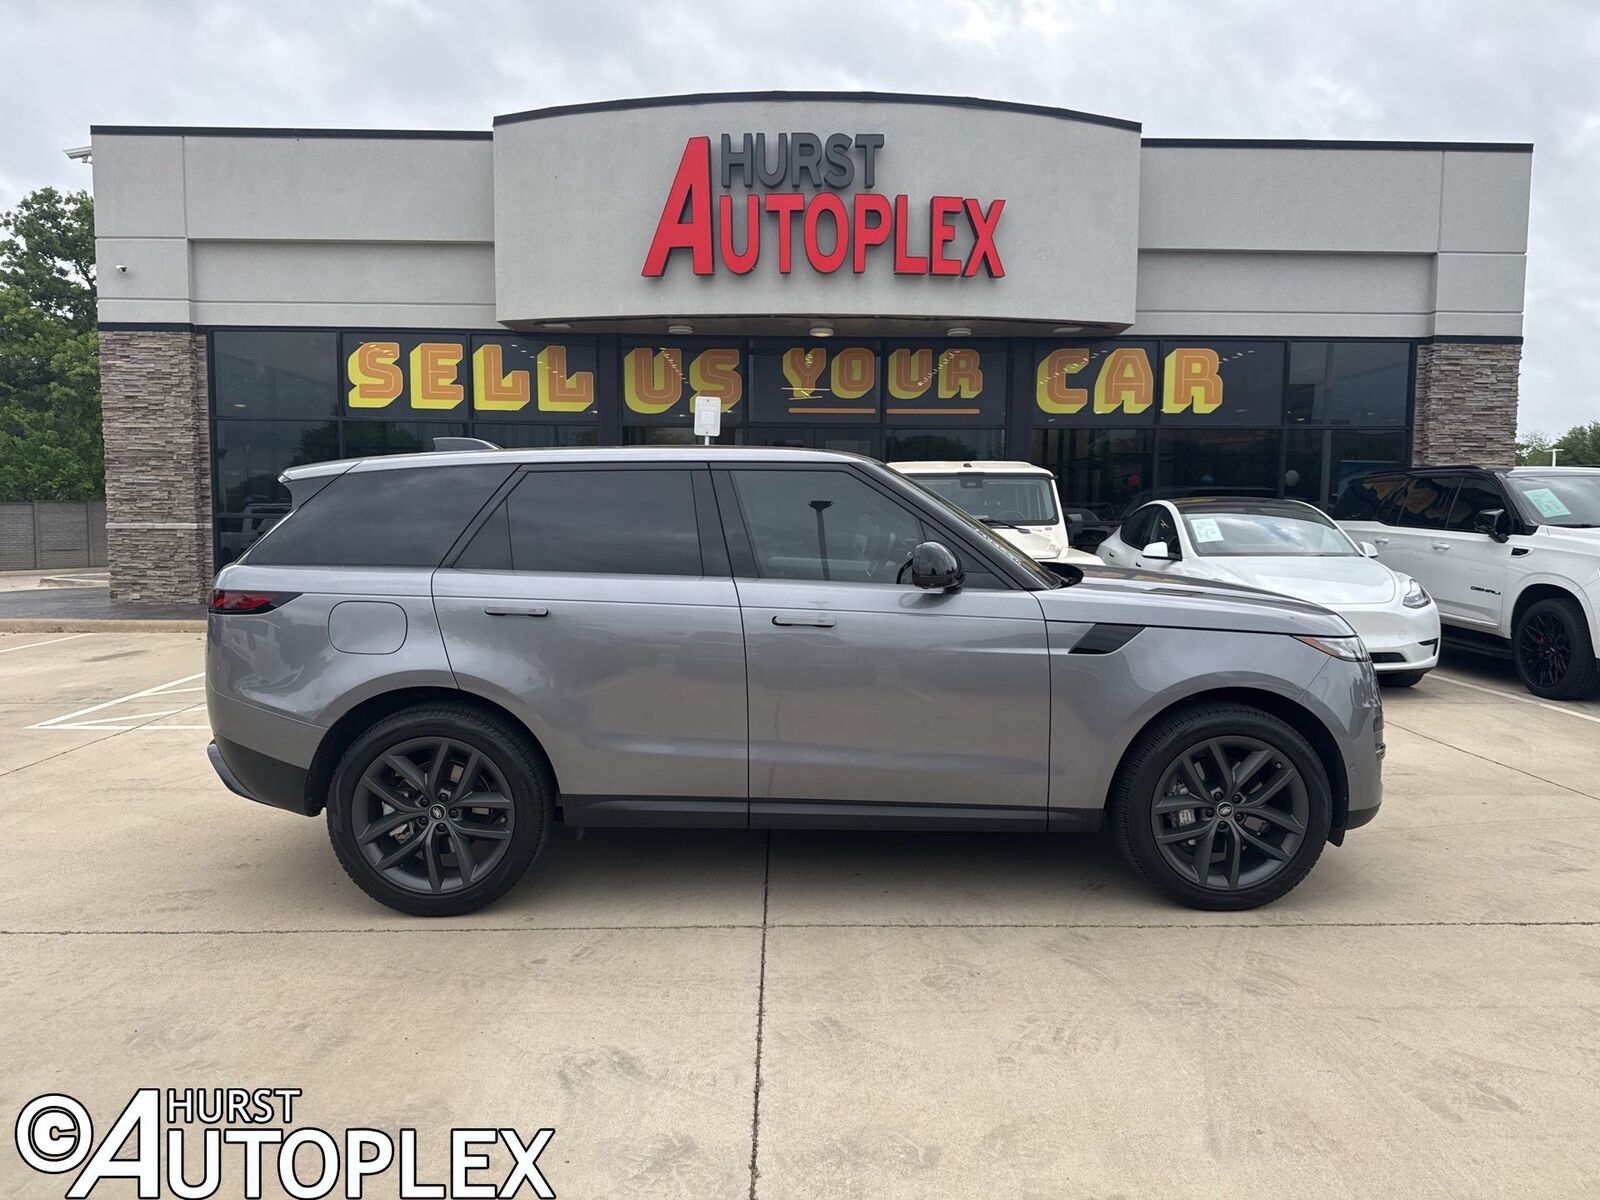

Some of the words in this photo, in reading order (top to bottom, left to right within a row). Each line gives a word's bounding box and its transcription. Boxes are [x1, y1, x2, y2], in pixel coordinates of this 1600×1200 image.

[722, 133, 884, 188] HURST
[642, 136, 1006, 278] AUTOPLEX
[348, 342, 594, 412] SELL
[624, 347, 742, 414] US
[781, 347, 983, 399] YOUR
[1036, 347, 1223, 414] CAR
